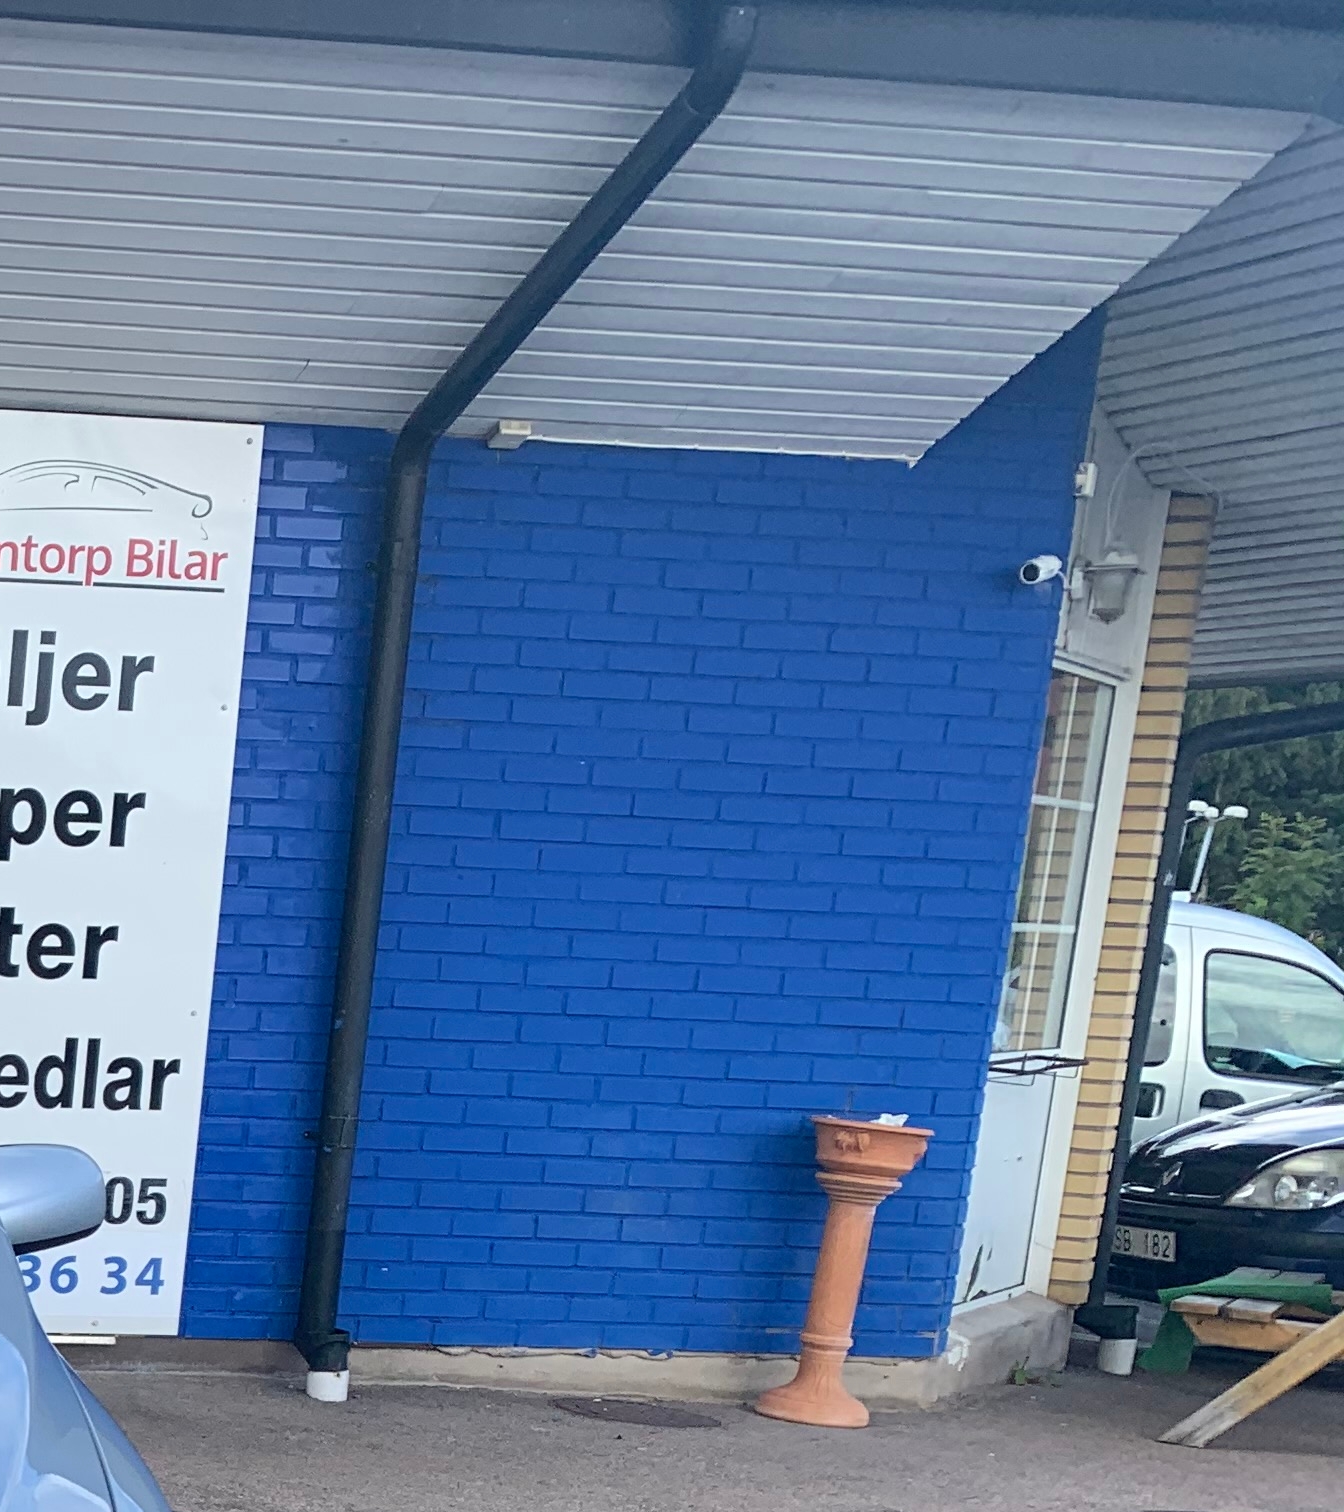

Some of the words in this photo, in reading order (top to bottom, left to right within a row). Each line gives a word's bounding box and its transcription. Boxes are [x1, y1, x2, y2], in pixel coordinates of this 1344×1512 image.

[125, 538, 228, 581] Bilar
[1144, 1232, 1170, 1258] 182
[99, 1256, 165, 1296] 34
